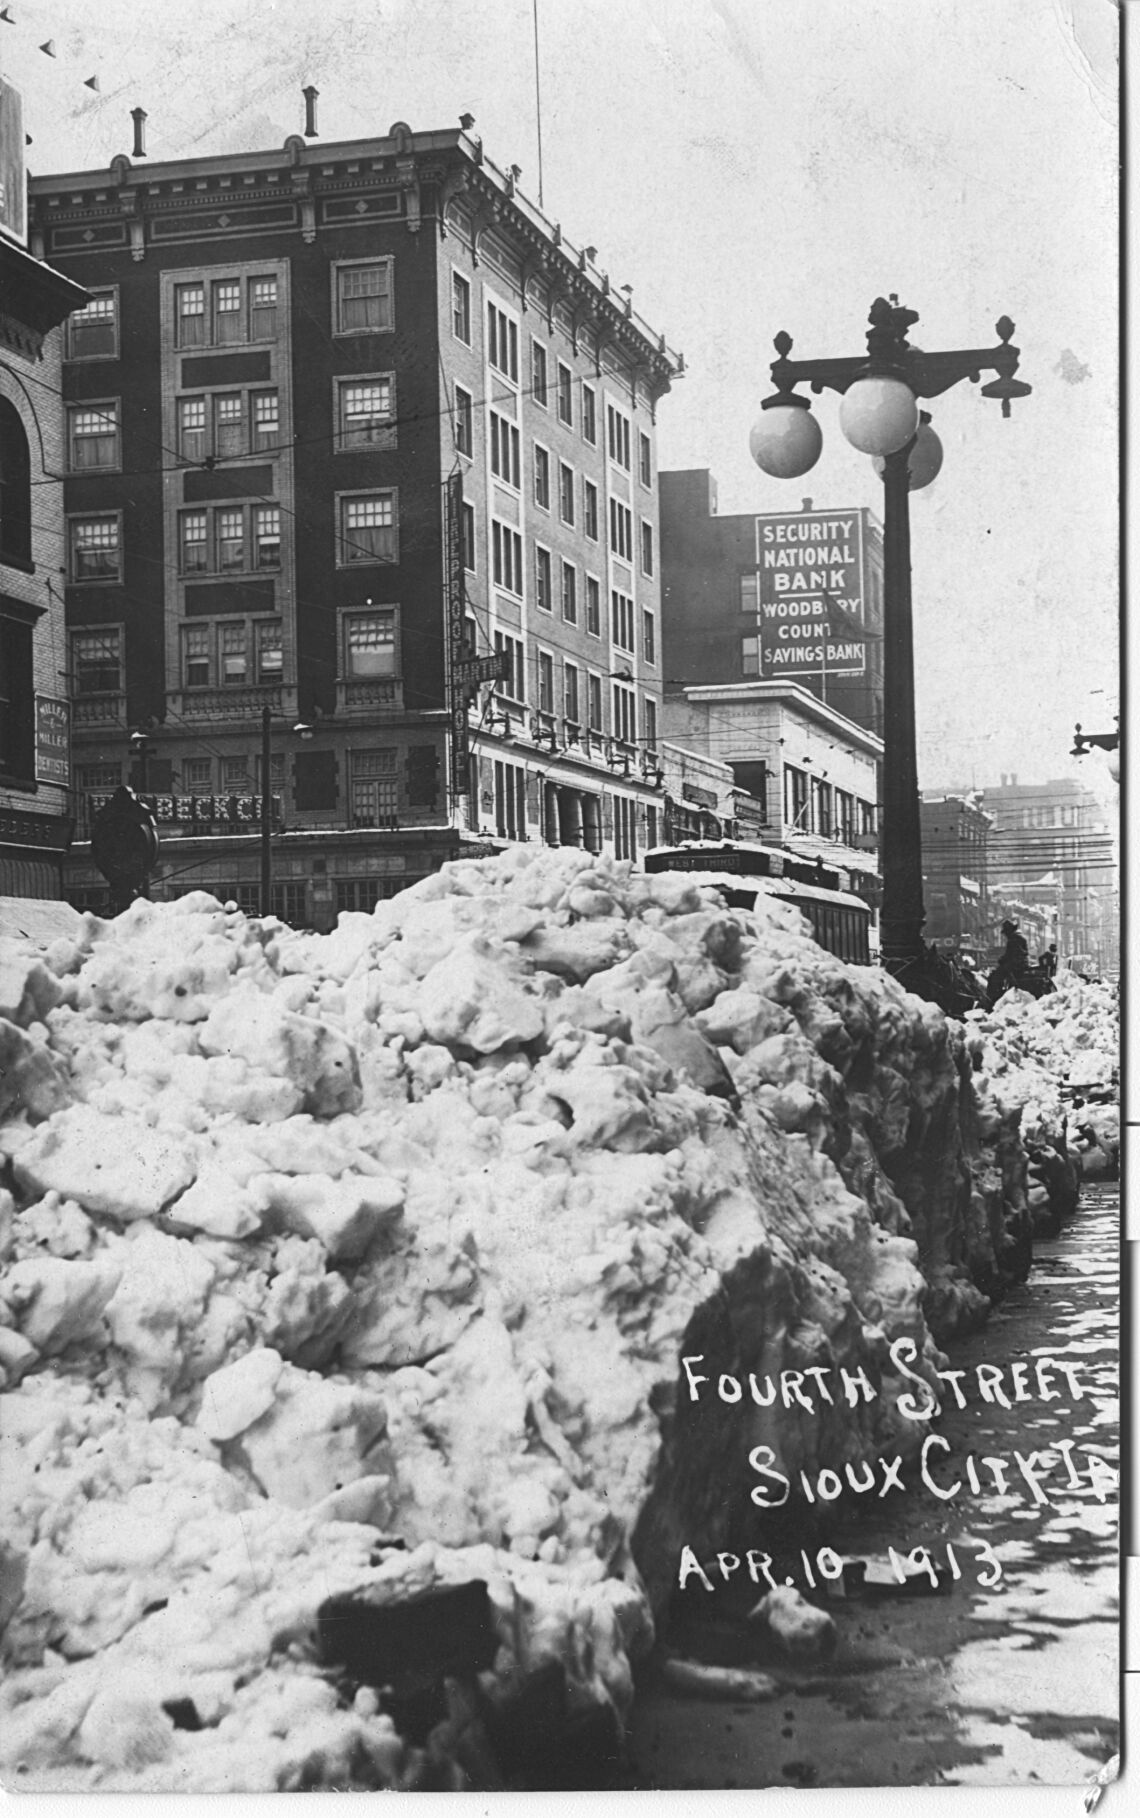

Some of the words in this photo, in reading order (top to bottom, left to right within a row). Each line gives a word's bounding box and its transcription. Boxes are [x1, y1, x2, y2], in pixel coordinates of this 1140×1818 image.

[763, 520, 853, 543] SECURITY
[764, 545, 855, 568] NATIONAL
[774, 569, 846, 591] BANK
[762, 598, 862, 618] WOODBRY
[764, 646, 824, 664] SAVINGS
[827, 643, 863, 660] BANK
[39, 702, 67, 725] MILLER
[39, 732, 68, 749] MILLER
[453, 688, 466, 793] HOTEL
[38, 755, 69, 776] DENTISTS
[156, 797, 230, 820] BECK
